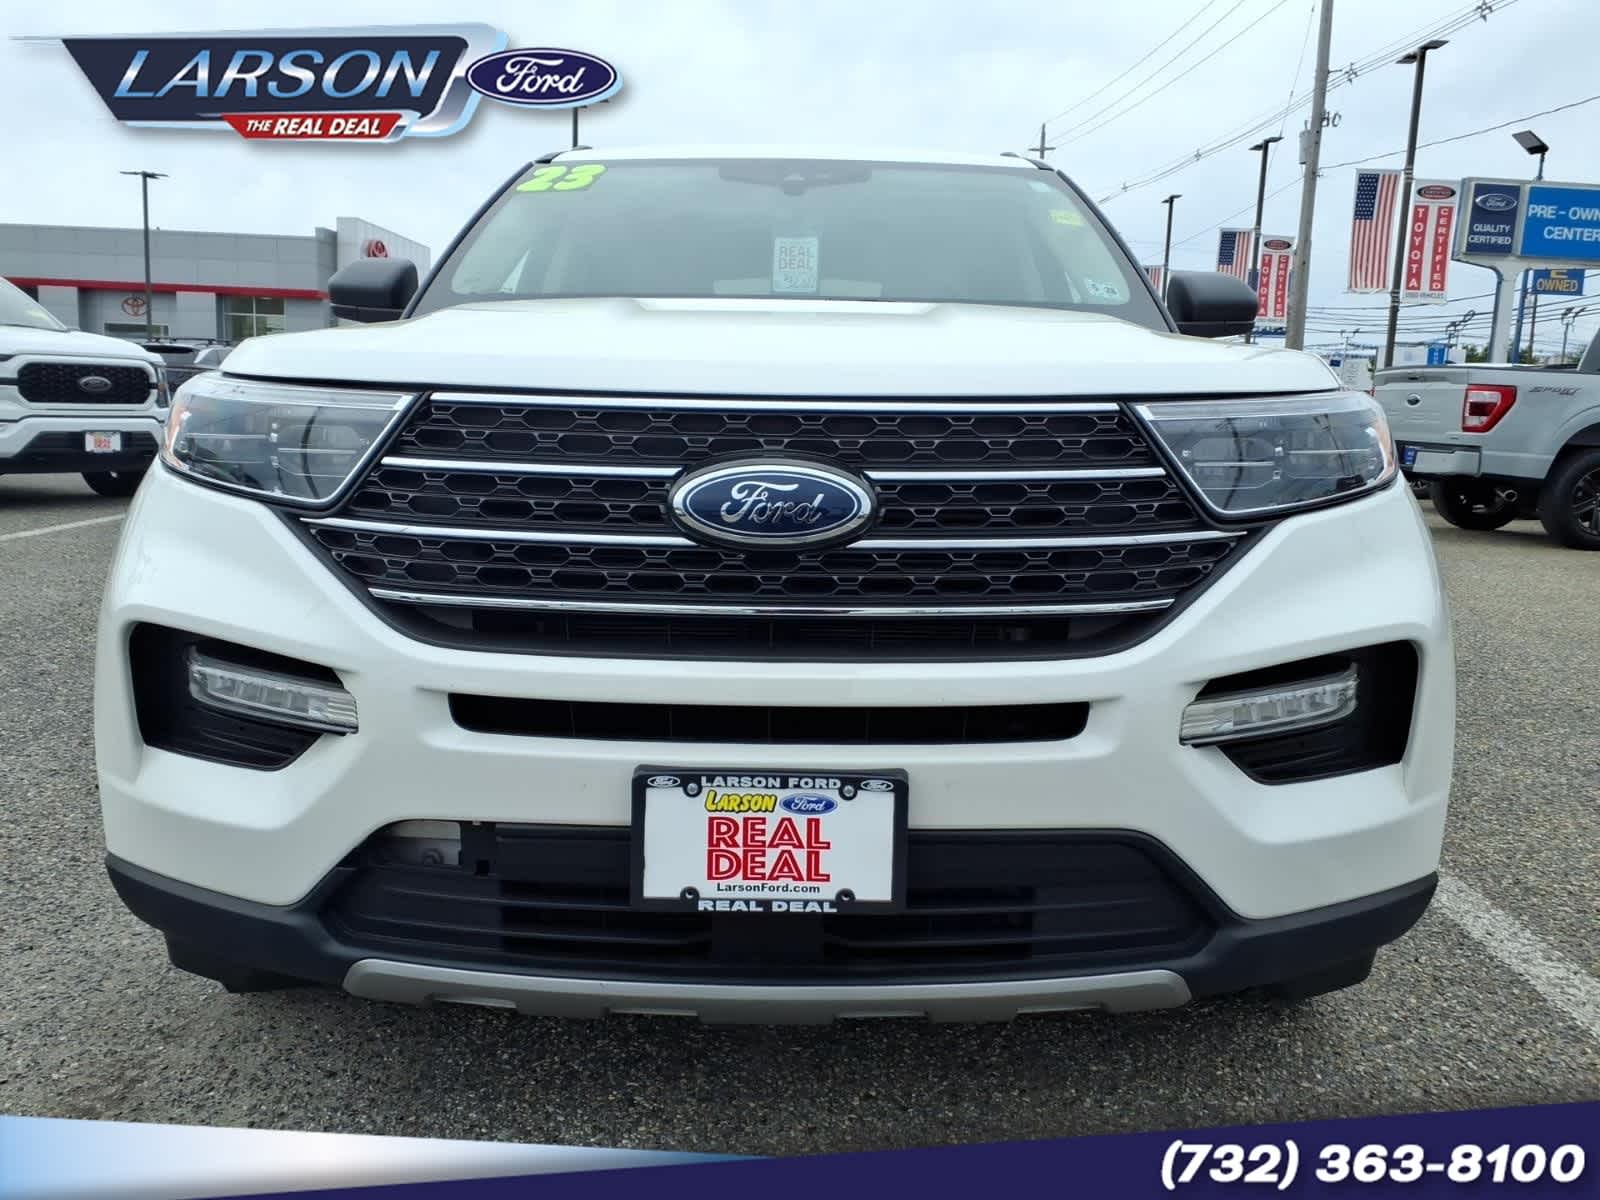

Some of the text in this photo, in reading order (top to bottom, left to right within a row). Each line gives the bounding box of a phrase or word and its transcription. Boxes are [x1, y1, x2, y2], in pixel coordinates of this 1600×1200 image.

[515, 163, 608, 192] 23
[1468, 235, 1511, 245] CERTIFIED
[1473, 223, 1510, 233] QUALITY
[1408, 208, 1425, 288] TOYOTA
[1432, 208, 1449, 290] CERTIFIED
[1258, 256, 1270, 315] TOYOTA
[1537, 279, 1578, 292] OWNED
[720, 480, 825, 523] Ford
[701, 775, 841, 790] LARSON FORD
[705, 790, 777, 813] LARSON
[708, 816, 831, 849] REAL
[706, 848, 831, 882] DEAL
[716, 882, 821, 894] LarsonFord.com
[698, 900, 837, 913] REAL DEAL
